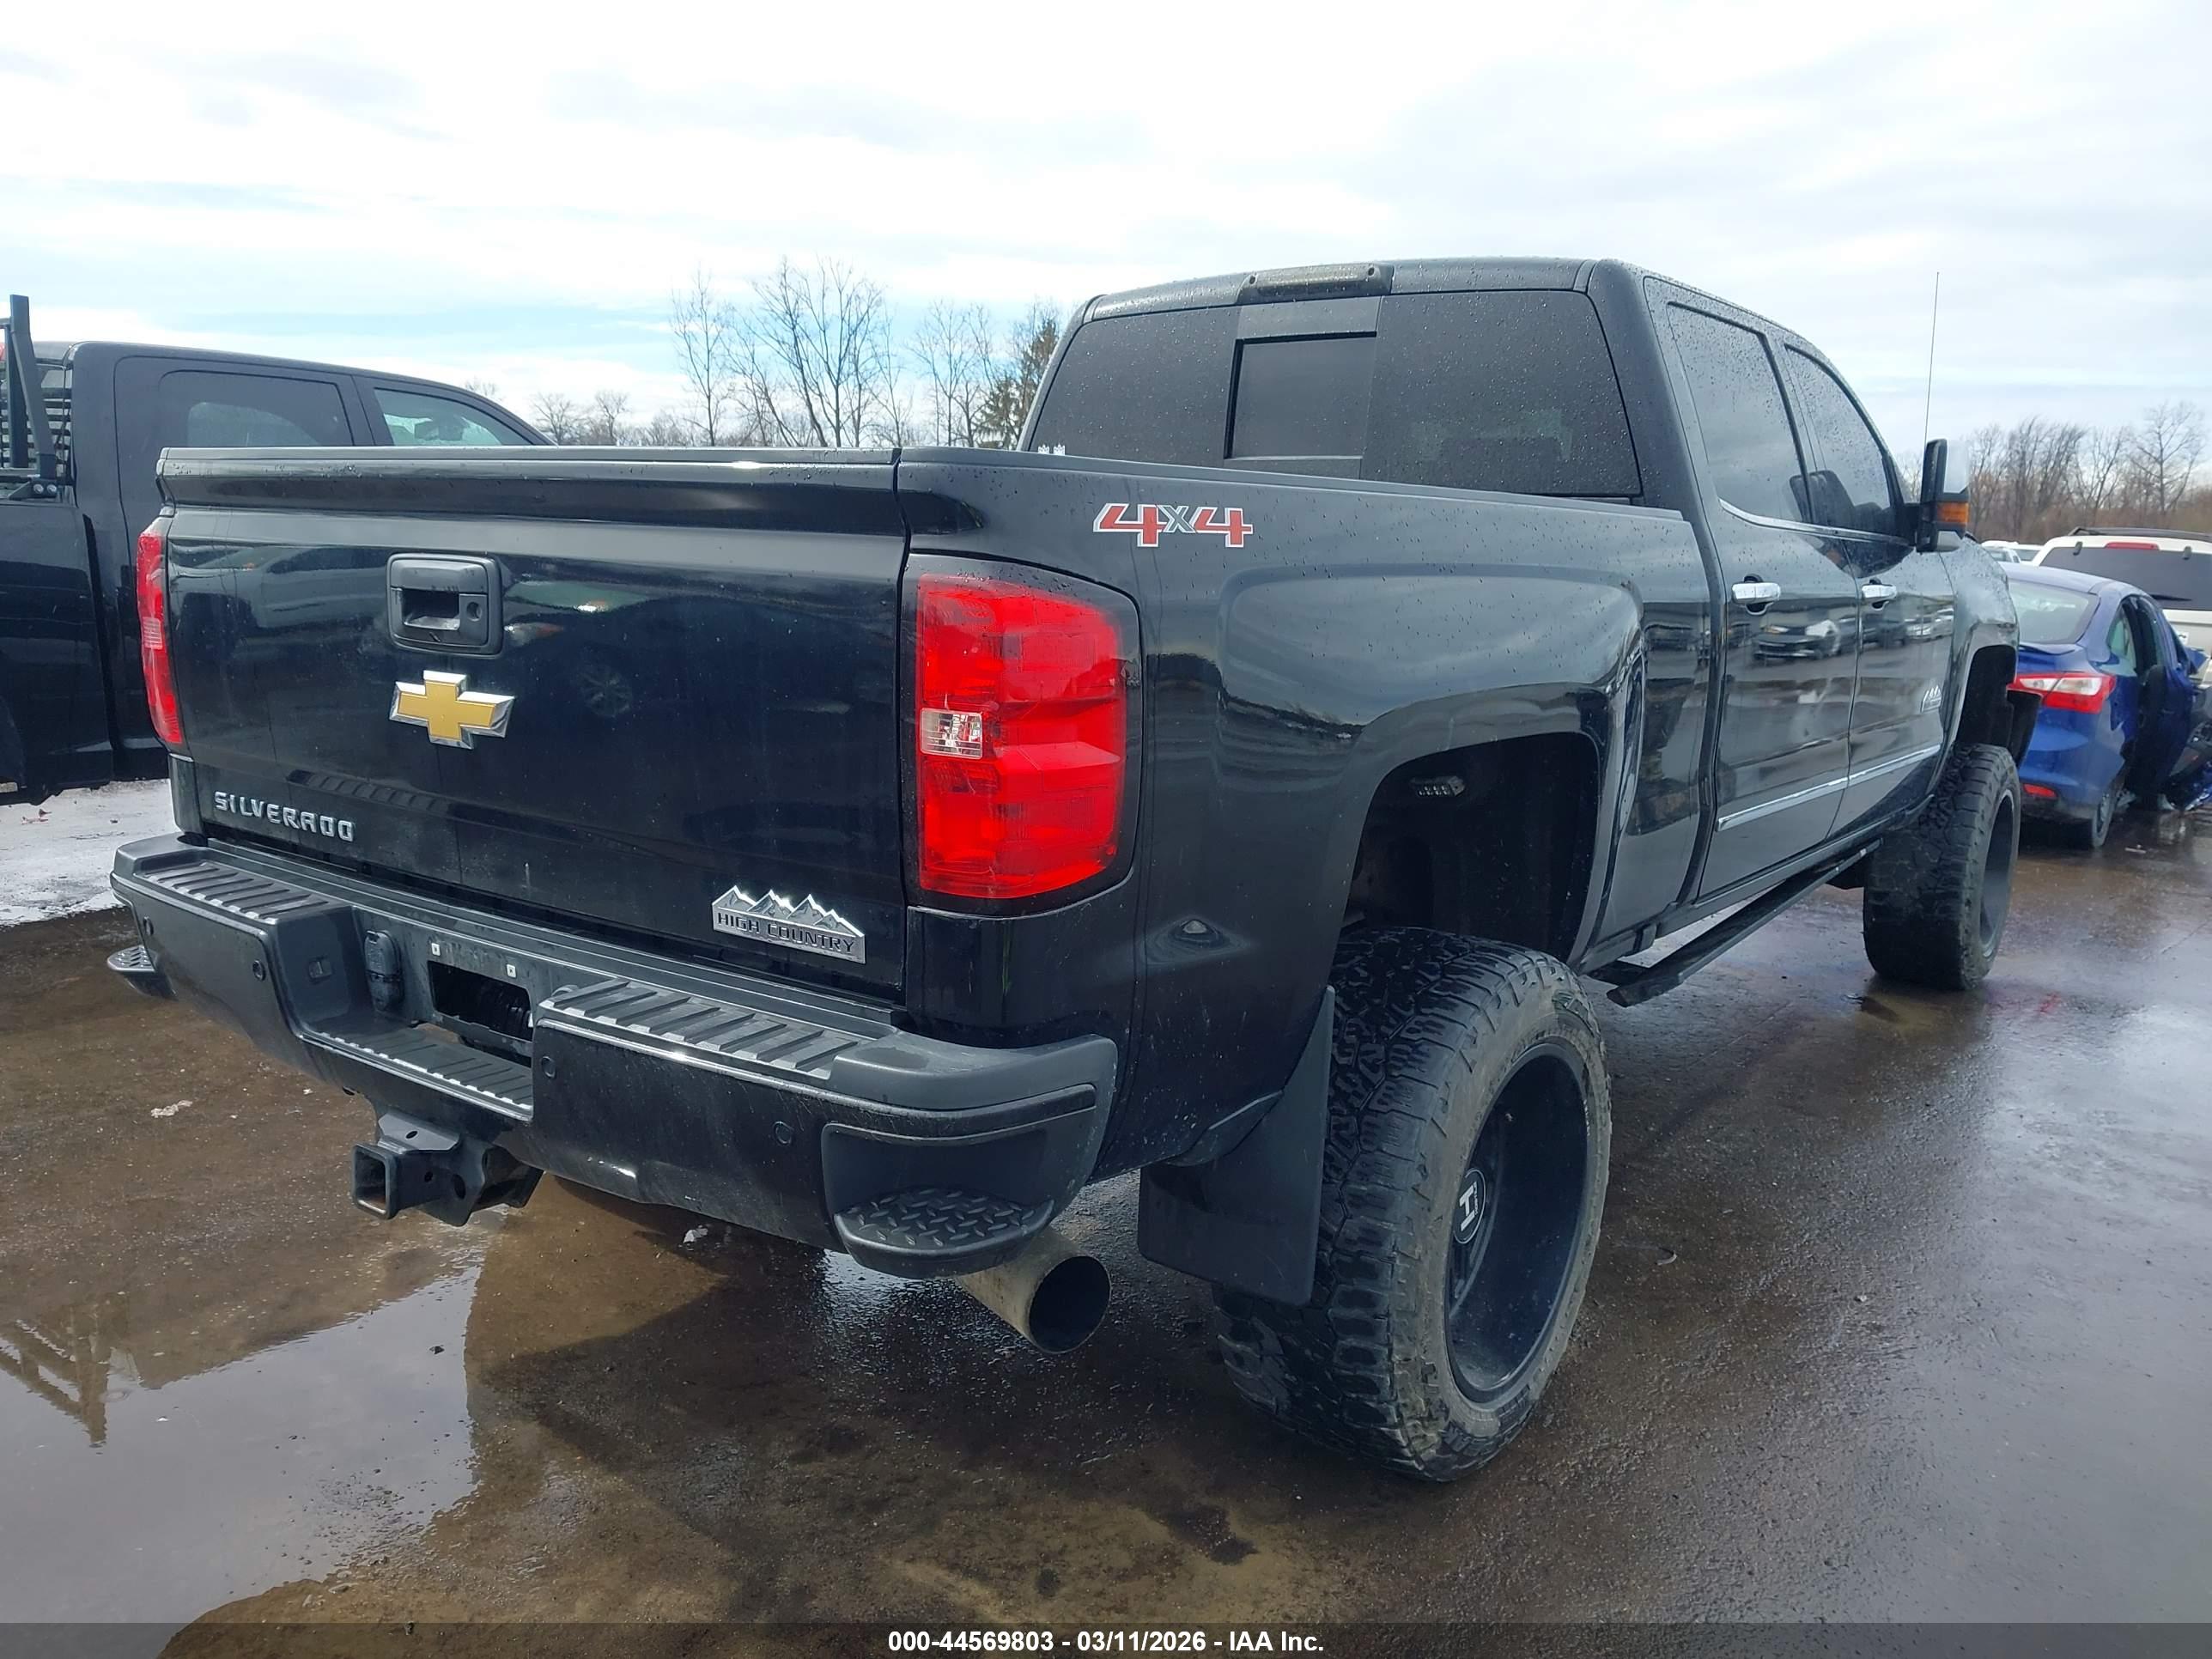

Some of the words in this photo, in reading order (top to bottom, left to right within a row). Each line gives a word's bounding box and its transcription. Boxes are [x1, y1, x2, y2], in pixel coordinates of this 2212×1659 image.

[215, 791, 355, 842] SILVERADO
[717, 911, 760, 934] HIGH
[767, 922, 854, 953] COUNTRY
